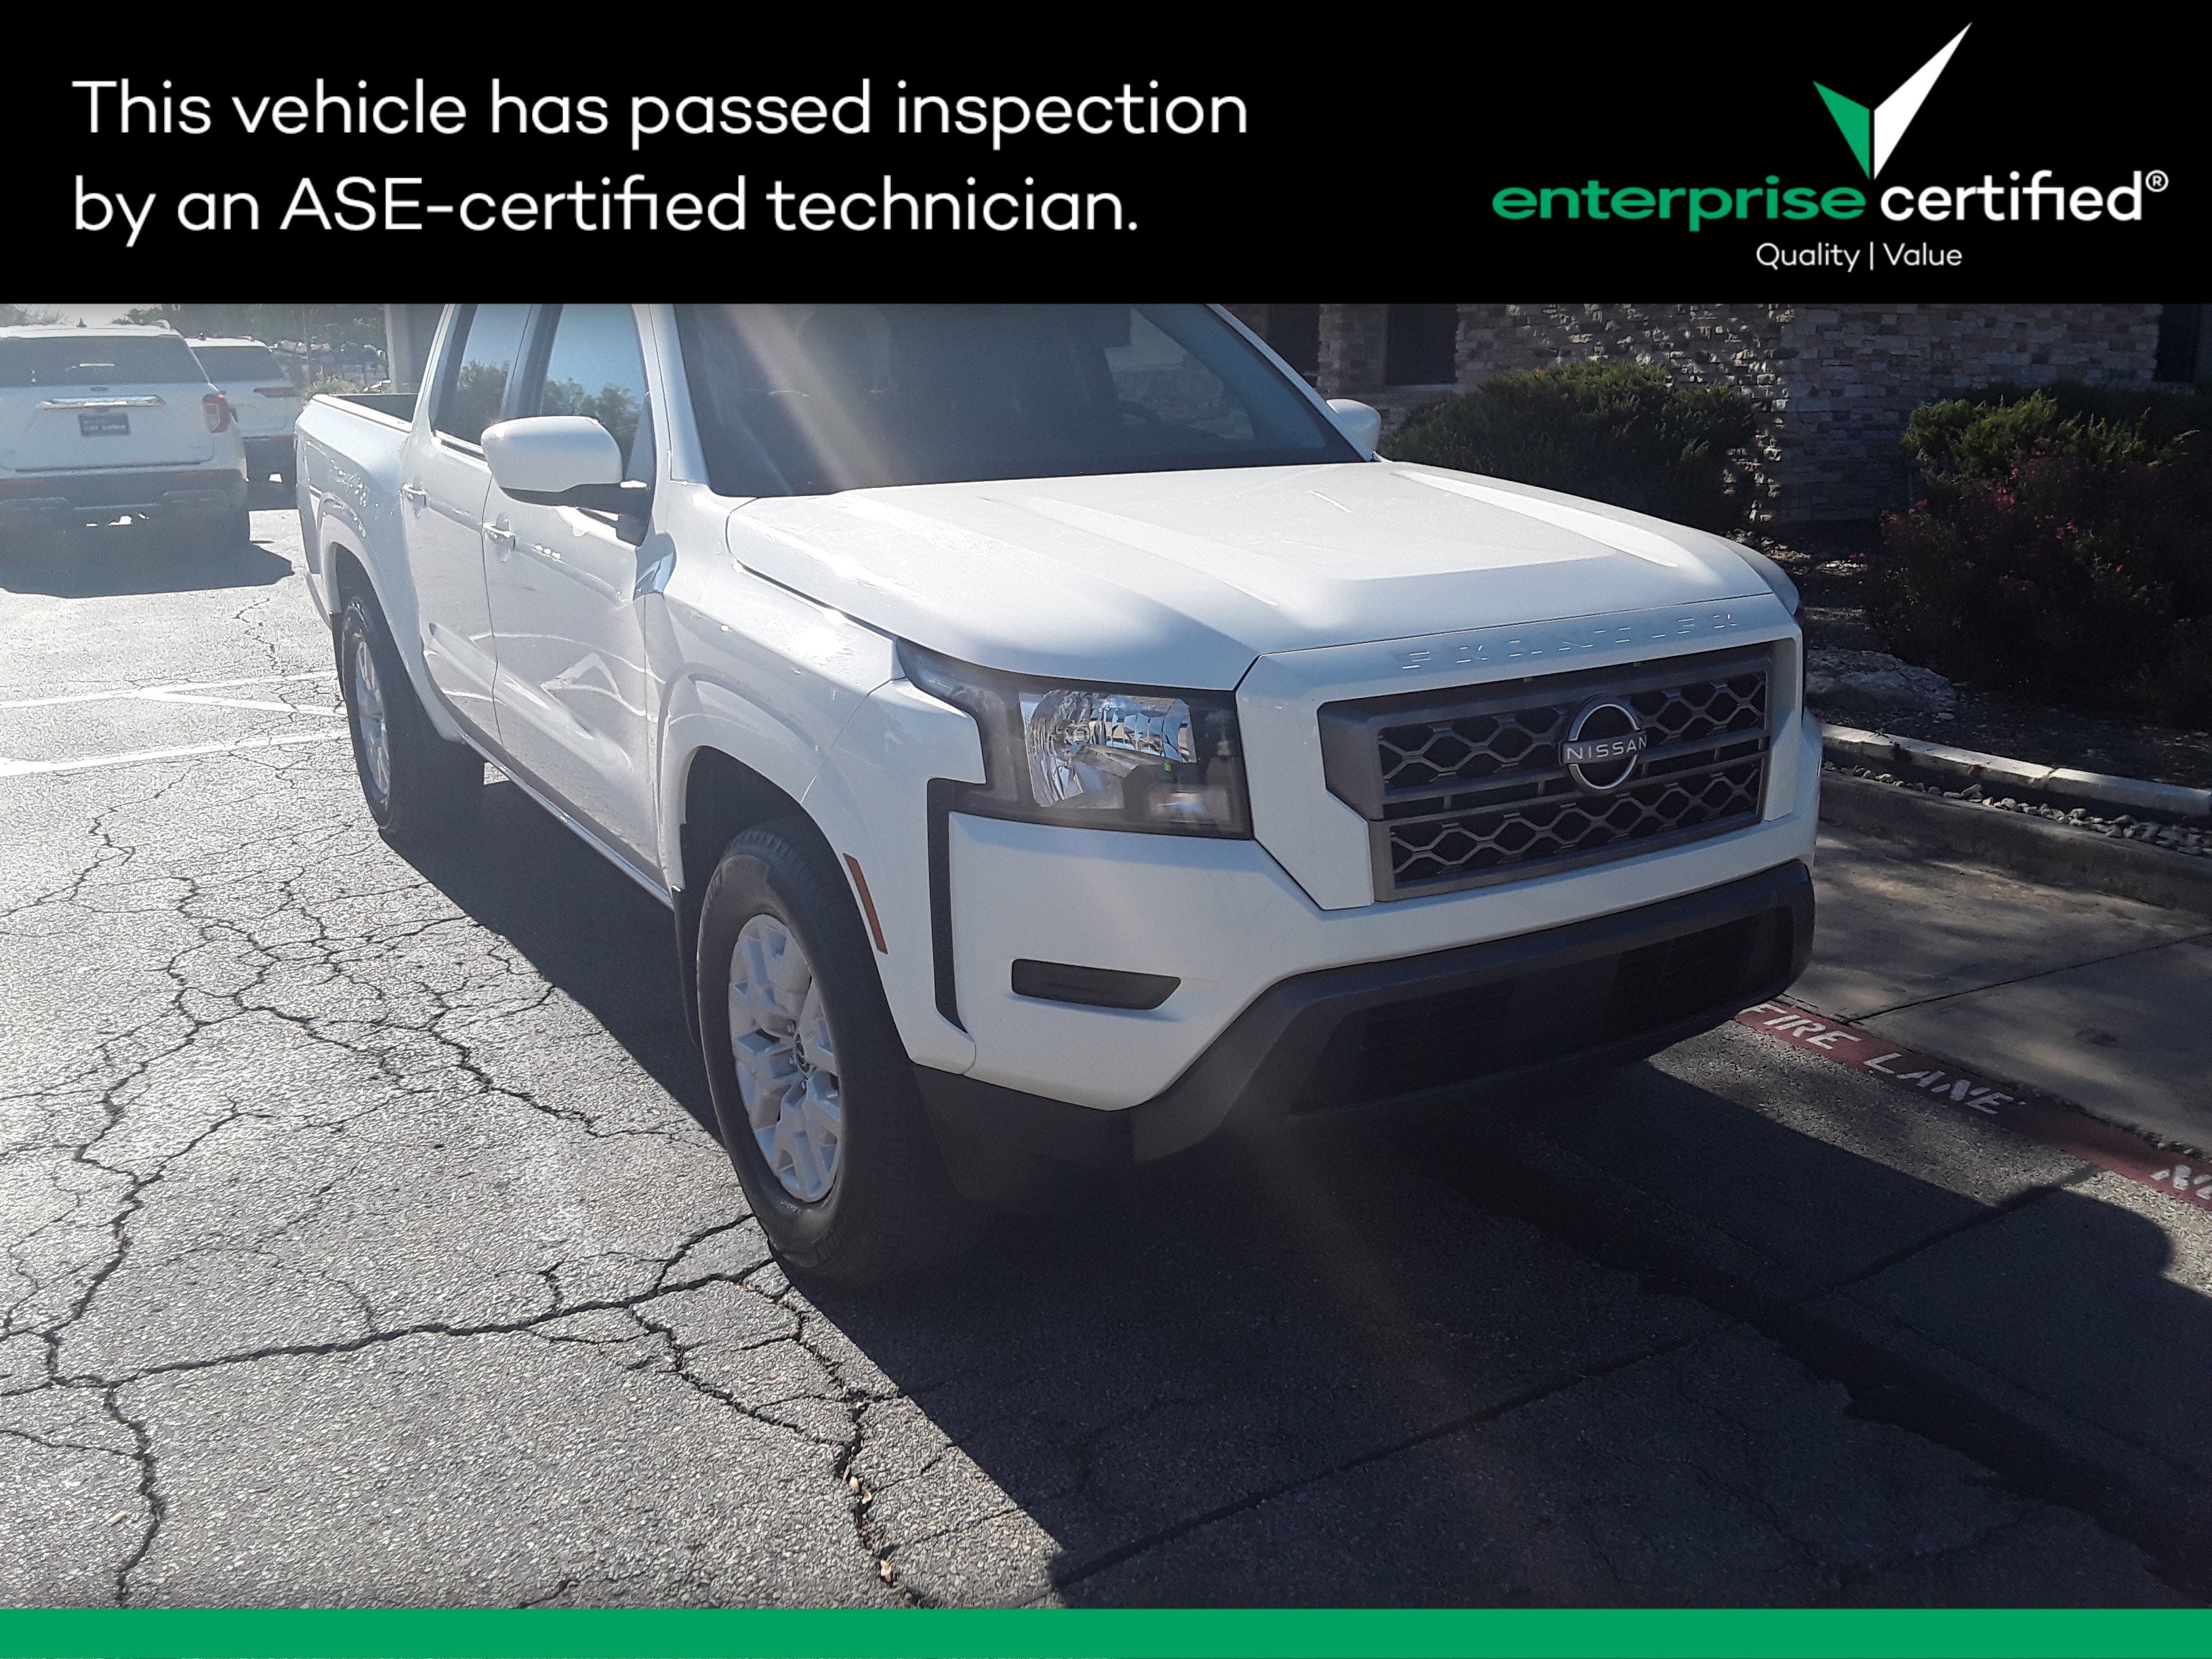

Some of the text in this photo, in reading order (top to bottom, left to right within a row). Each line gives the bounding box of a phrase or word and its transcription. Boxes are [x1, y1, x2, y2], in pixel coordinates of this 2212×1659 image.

[1567, 735, 1646, 760] NISSAN
[1738, 1003, 2013, 1115] FIRE LANE
